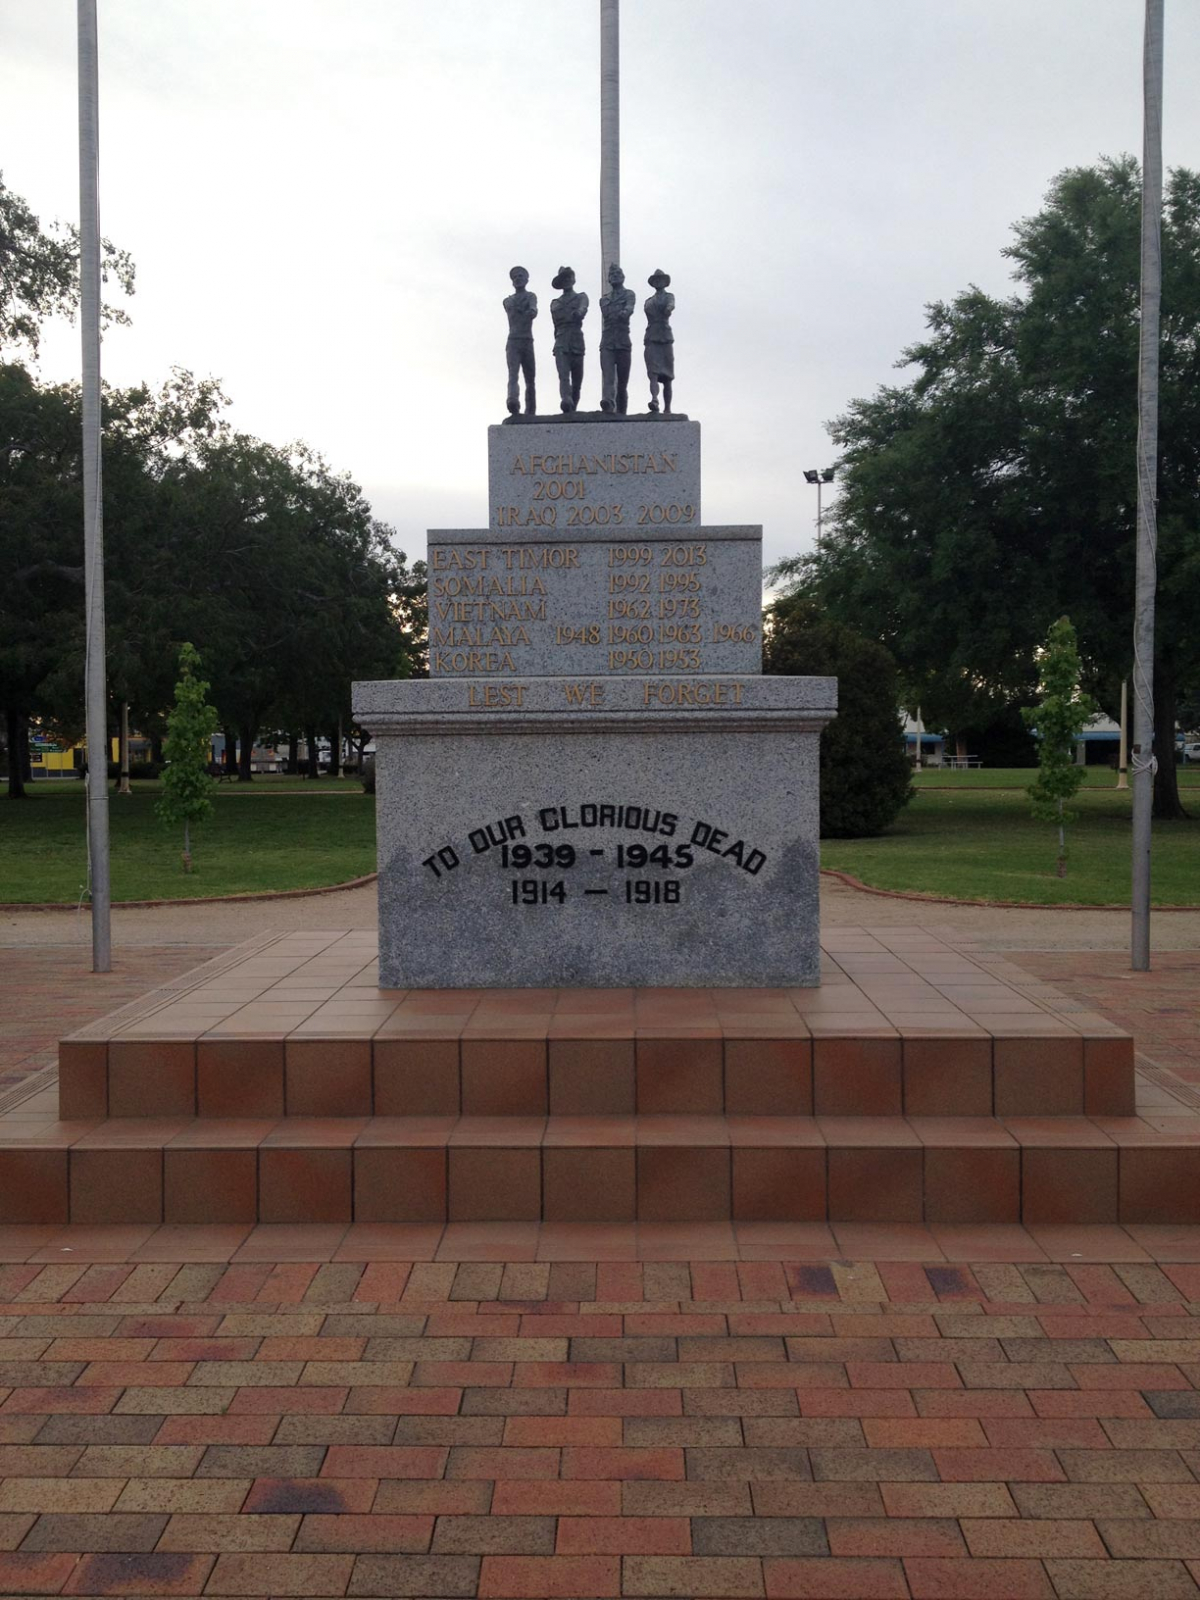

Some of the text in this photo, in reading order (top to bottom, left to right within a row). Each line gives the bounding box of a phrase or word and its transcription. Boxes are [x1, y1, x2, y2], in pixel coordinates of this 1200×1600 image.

[511, 454, 678, 474] AFGHANISTAN
[533, 480, 584, 500] 2001
[497, 503, 696, 526] IRAQ 2003 2009
[432, 545, 707, 571] EAST TIMOR 1999 2013
[433, 572, 701, 597] SOMALIA 1992 1995
[434, 599, 700, 622] VIETNAM 1962 1973
[433, 623, 755, 647] MALAYA 1948 1960 1963 1966
[434, 650, 701, 672] KOREA 1950 1953
[468, 683, 745, 707] LEST WE FORGET
[422, 803, 767, 878] TO OUR GLORIOUS DEAD
[501, 844, 577, 869] 1939
[616, 844, 695, 869] 1945
[512, 880, 567, 904] 1914
[625, 880, 681, 904] 1918
